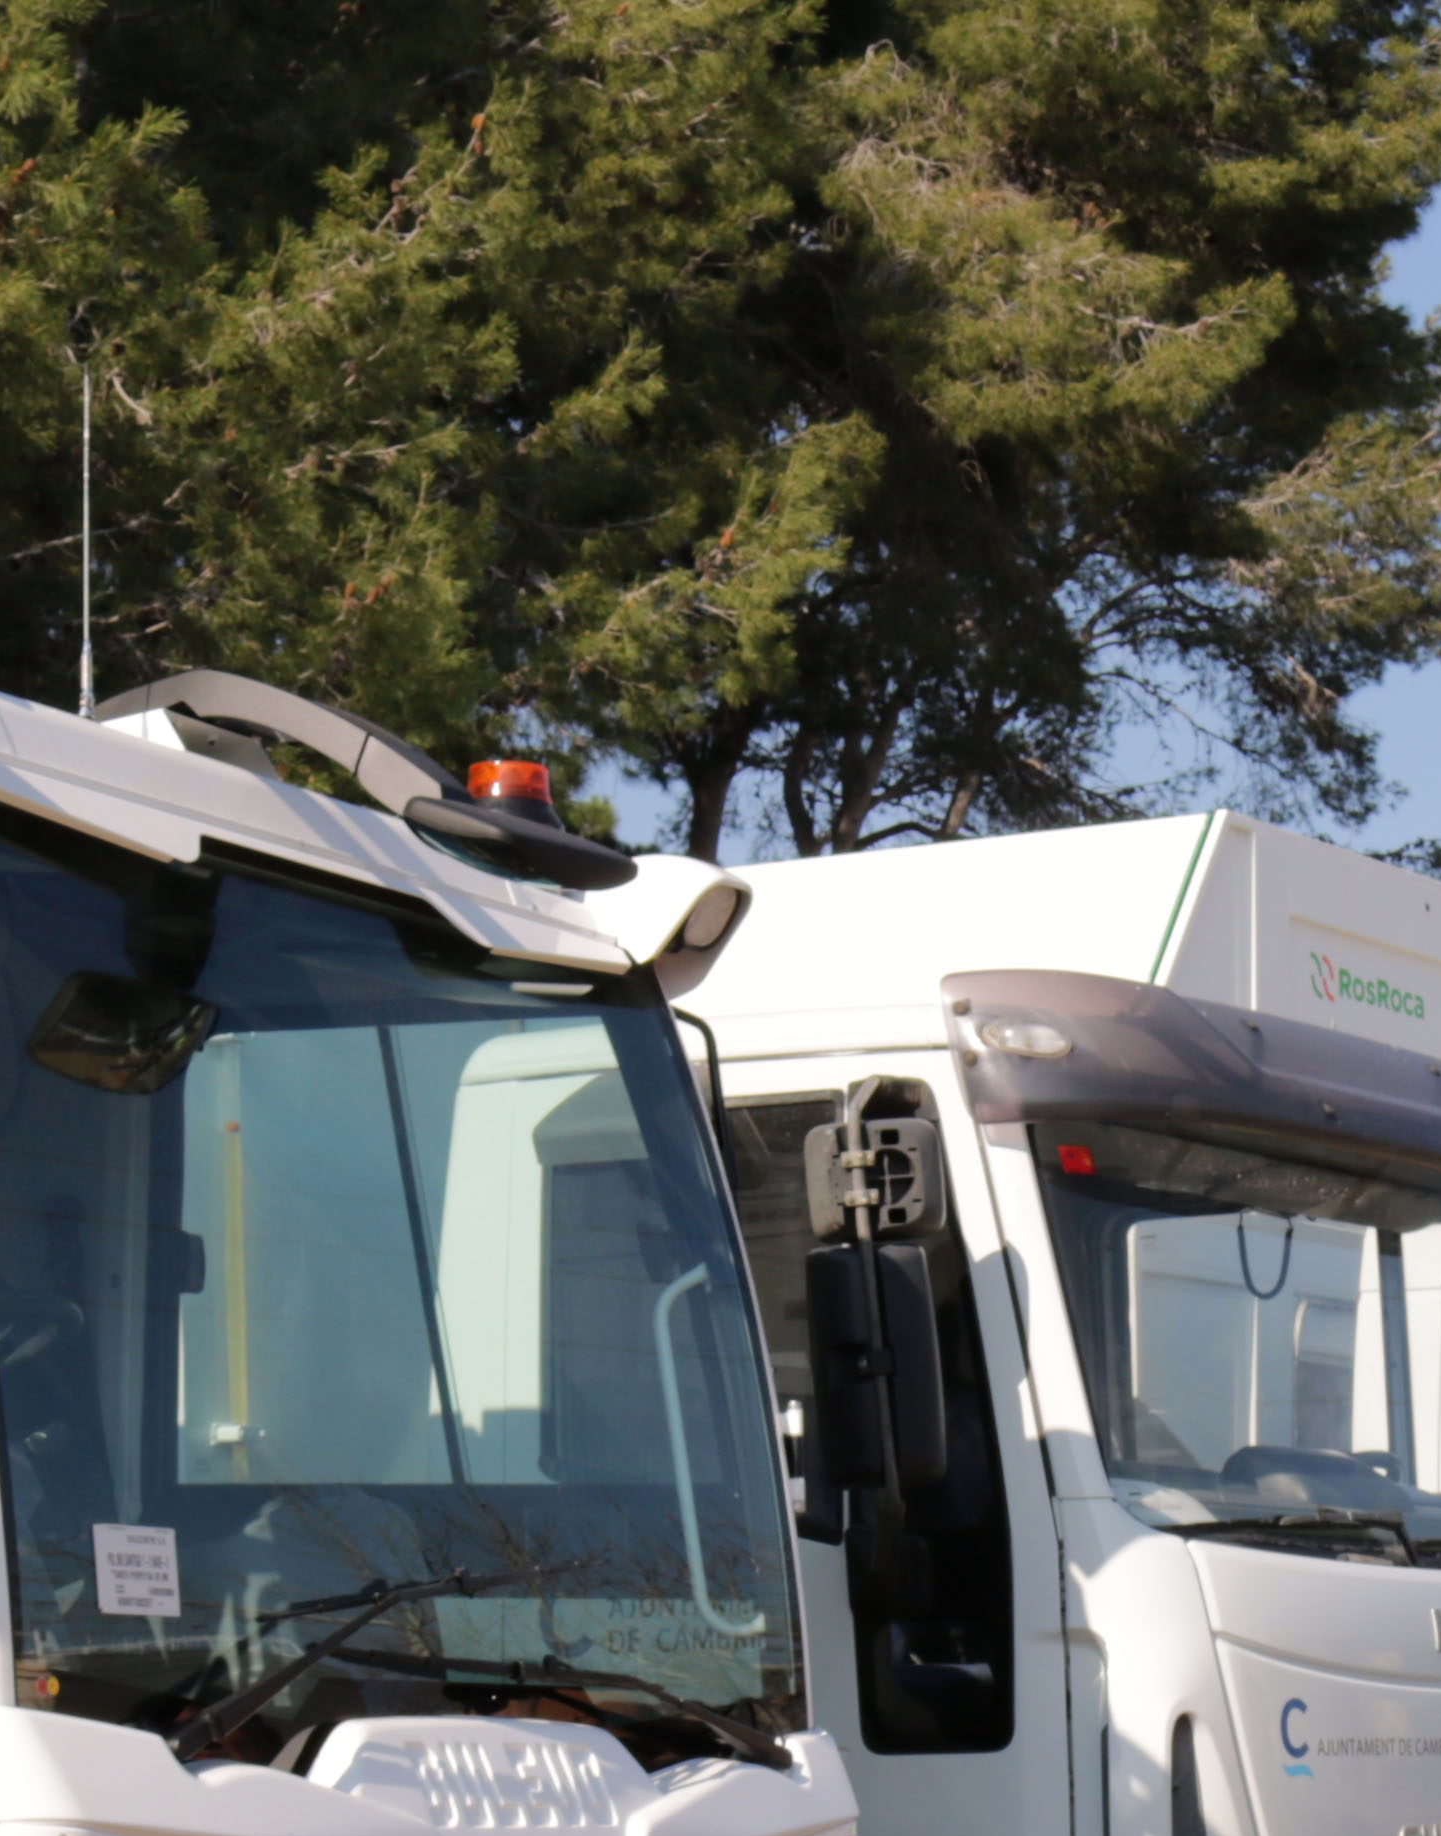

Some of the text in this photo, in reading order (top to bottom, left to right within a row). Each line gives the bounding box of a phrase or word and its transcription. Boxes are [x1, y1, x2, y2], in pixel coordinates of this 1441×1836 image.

[1338, 967, 1424, 1019] RosRoca
[1317, 1737, 1396, 1757] AJUNTAMENT
[1398, 1737, 1413, 1757] DE
